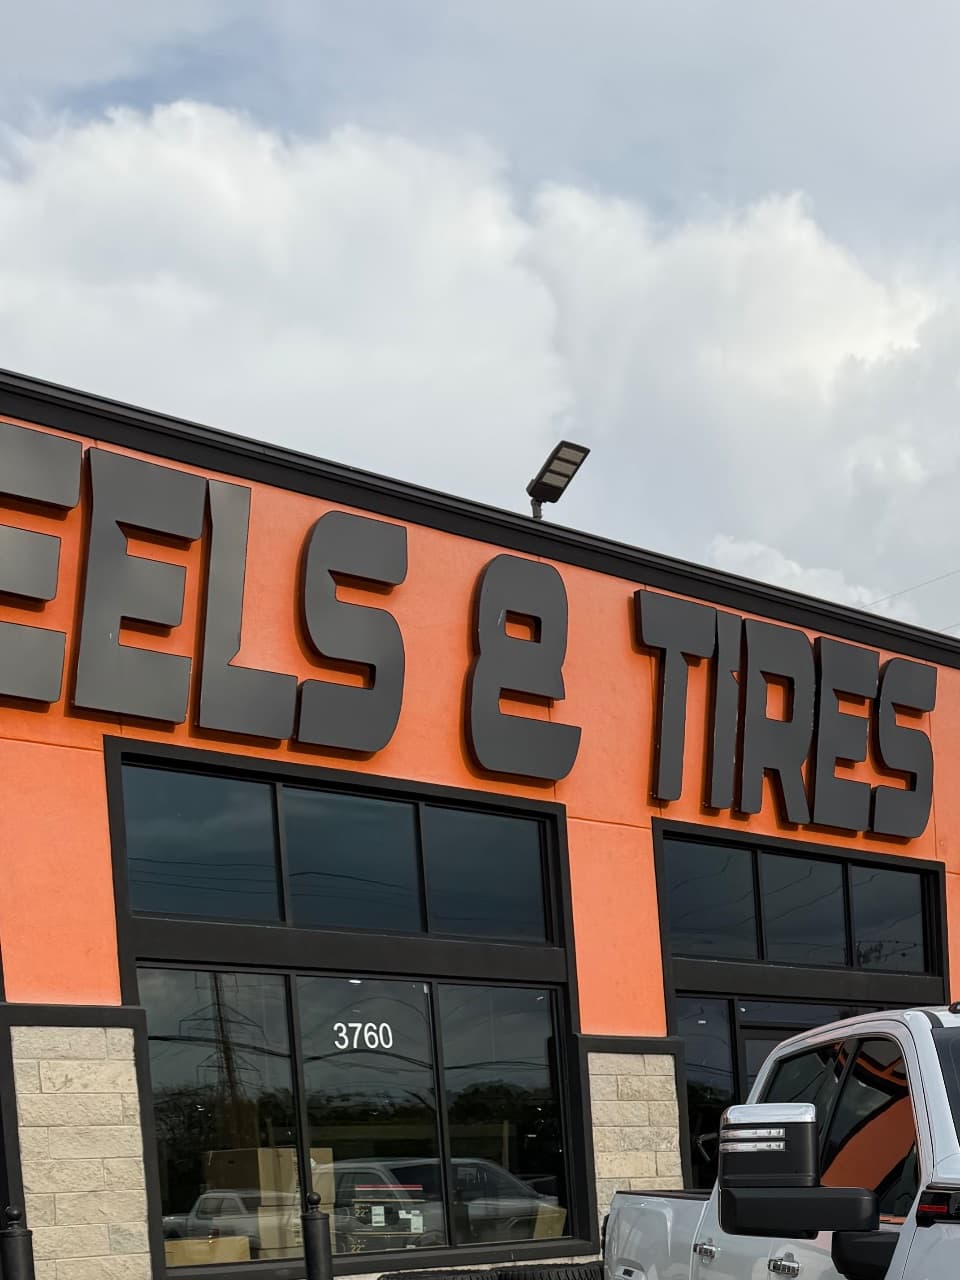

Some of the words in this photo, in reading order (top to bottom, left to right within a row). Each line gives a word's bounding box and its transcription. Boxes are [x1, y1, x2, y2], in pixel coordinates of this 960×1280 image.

[466, 553, 582, 781] &
[634, 589, 938, 839] TIRES
[333, 1022, 393, 1049] 3760
